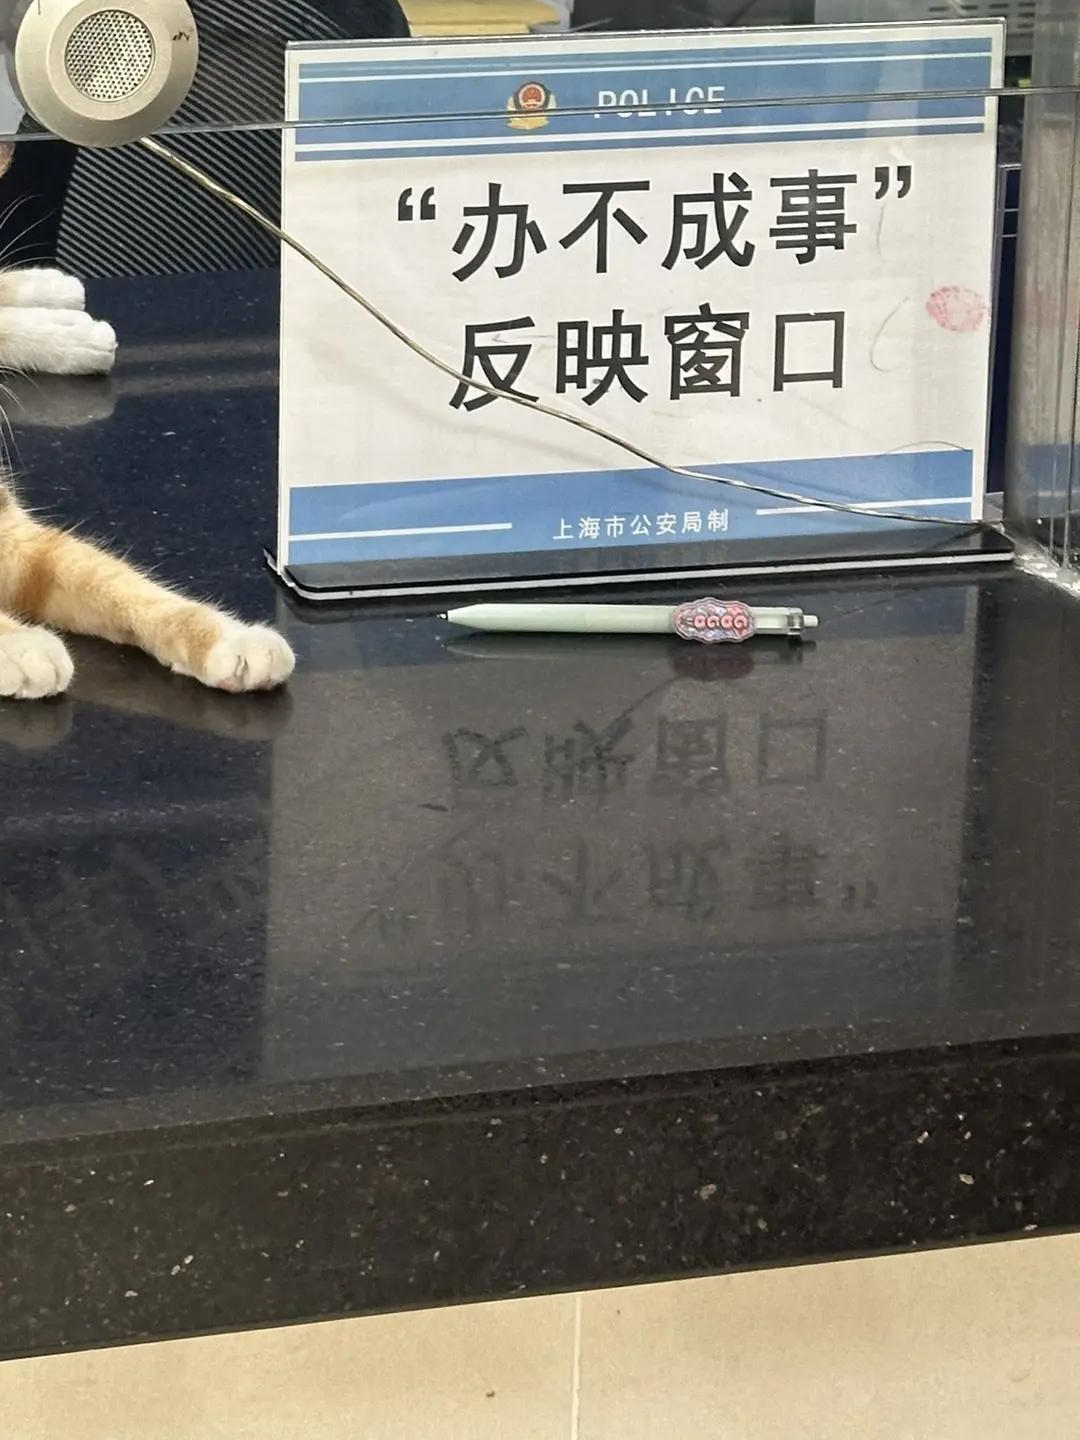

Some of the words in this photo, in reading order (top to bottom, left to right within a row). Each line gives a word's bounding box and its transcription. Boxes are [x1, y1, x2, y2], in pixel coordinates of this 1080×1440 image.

[594, 86, 726, 119] POLICE
[397, 165, 912, 283] “办不成事”
[449, 302, 846, 412] 反映窗口
[553, 508, 729, 540] 上海市公安局制
